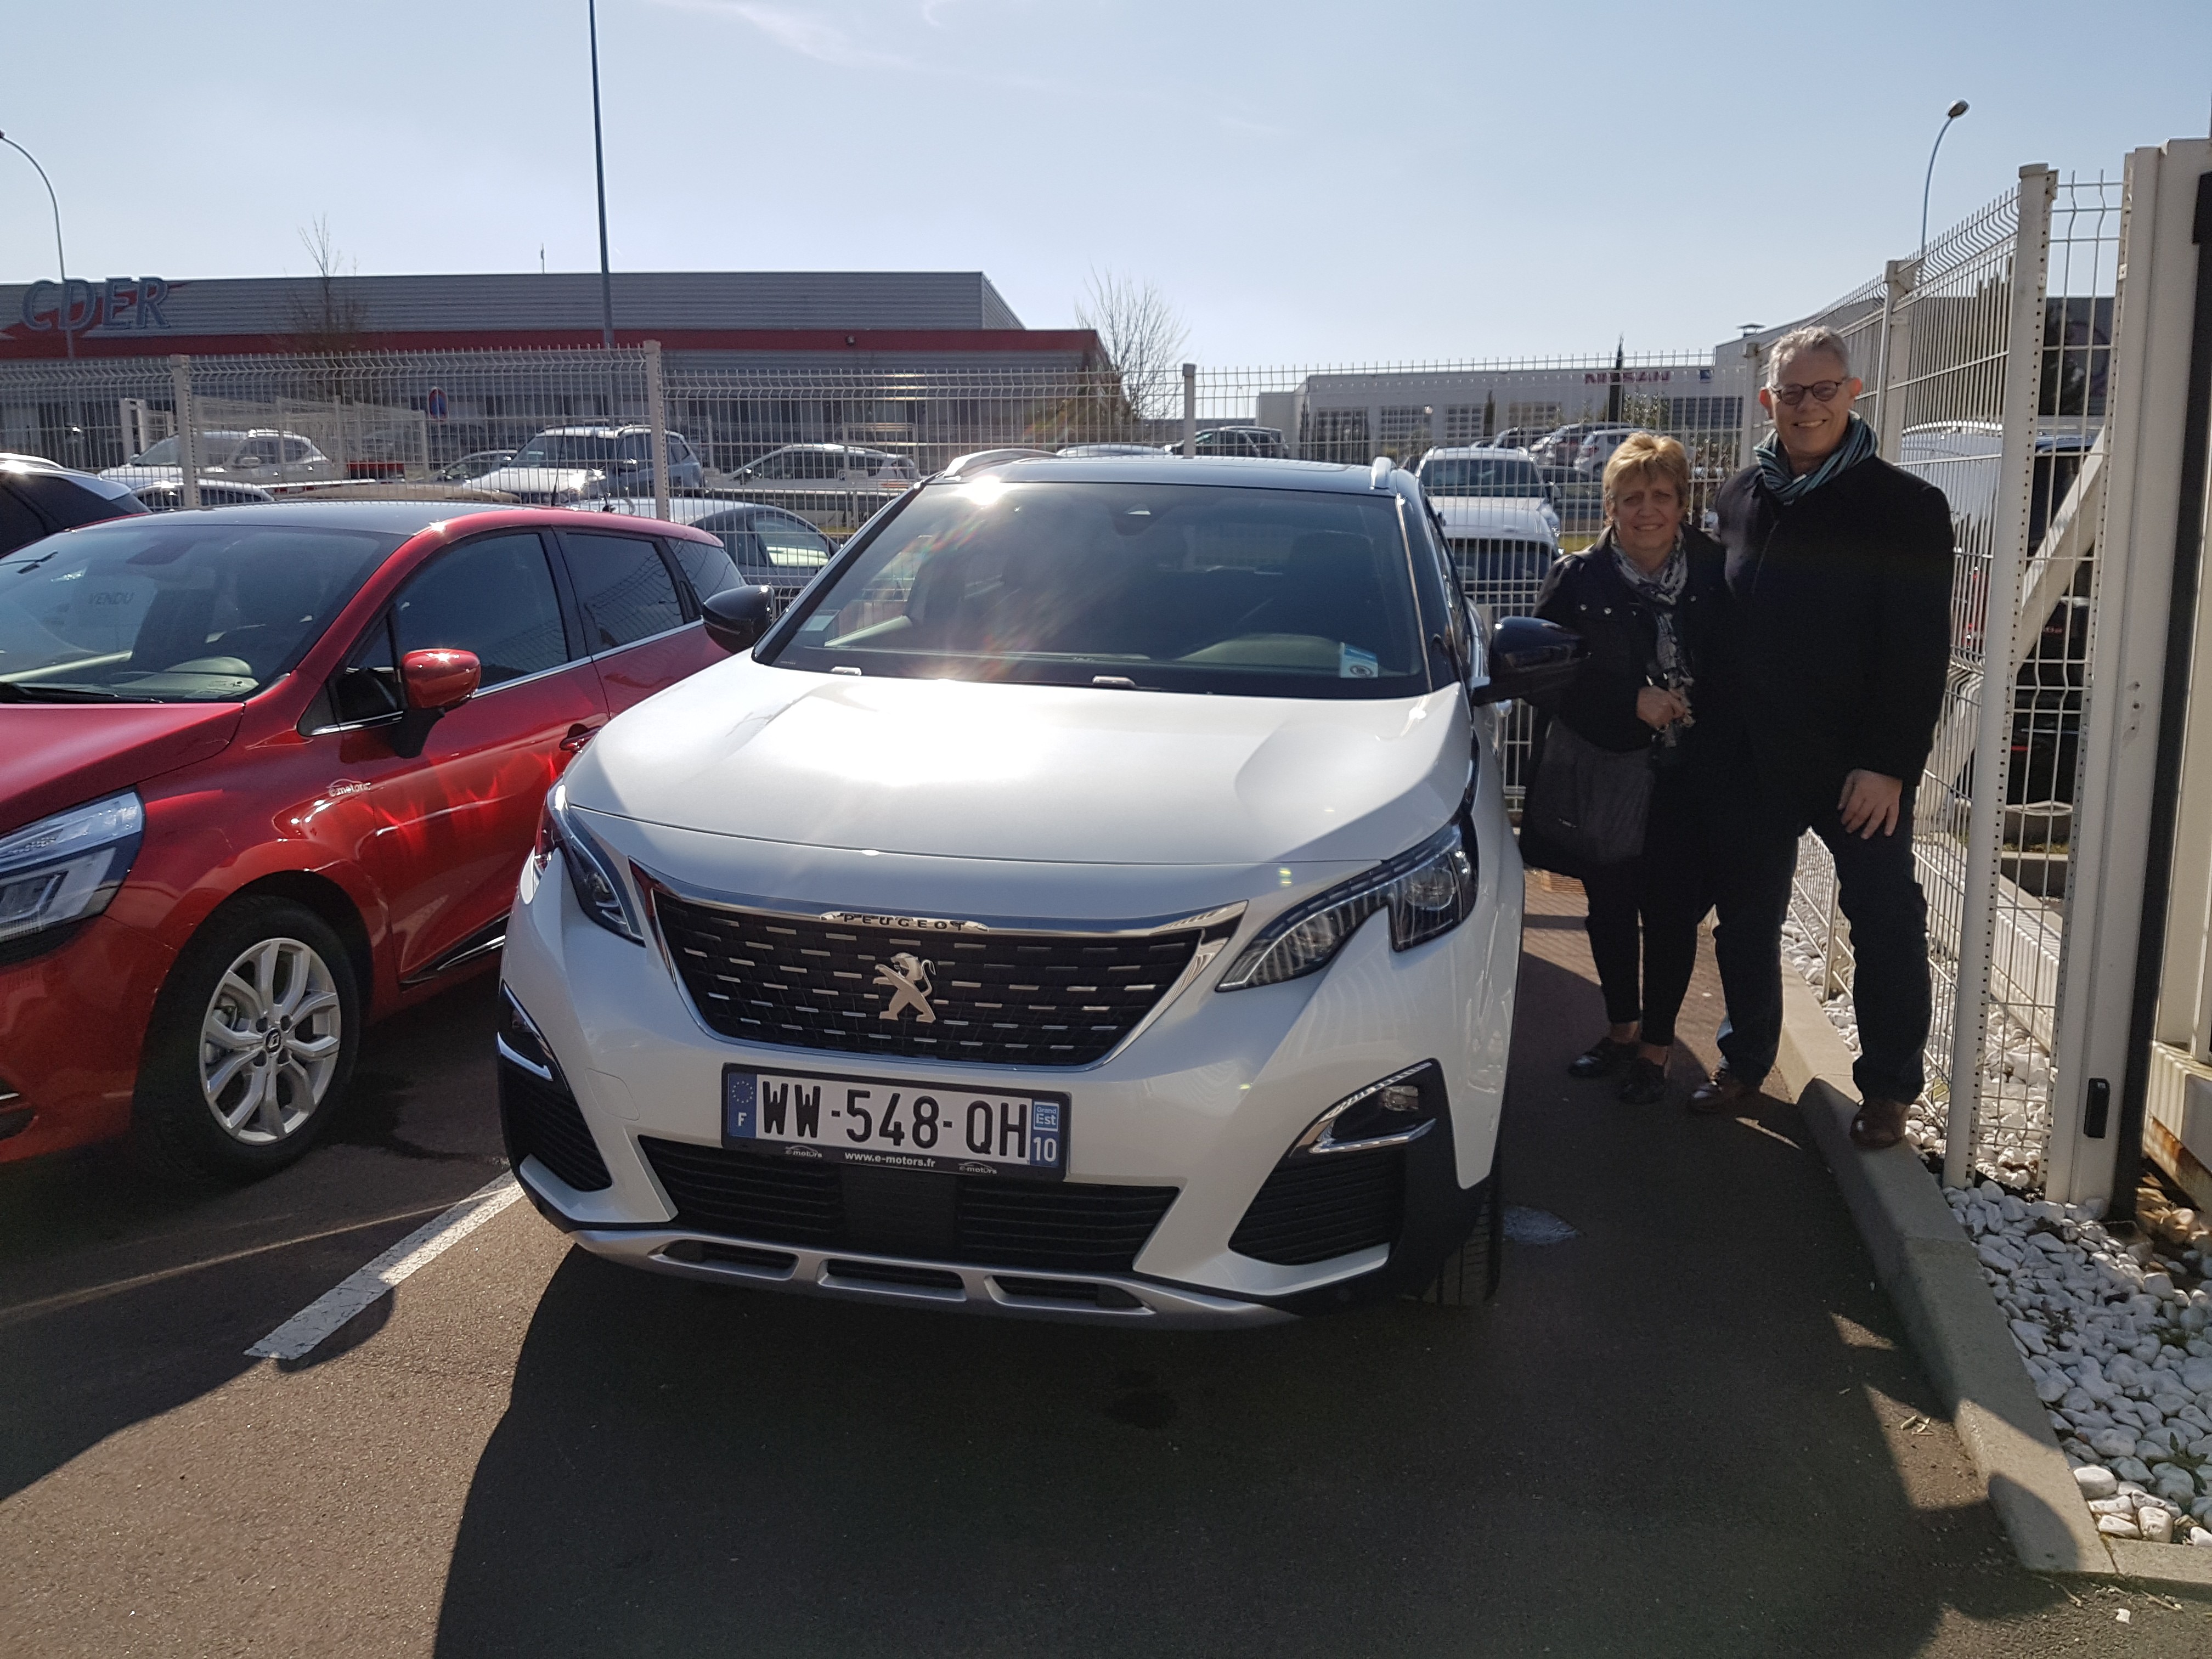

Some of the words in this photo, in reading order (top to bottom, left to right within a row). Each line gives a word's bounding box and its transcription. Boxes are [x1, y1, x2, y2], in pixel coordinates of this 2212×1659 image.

[22, 277, 171, 331] CDER
[1584, 371, 1671, 385] NISAN
[844, 913, 966, 931] PEUGEOT
[738, 1112, 747, 1126] F
[762, 1080, 1028, 1158] WW-548-QH
[1036, 1113, 1057, 1126] Est
[1034, 1137, 1057, 1162] 10
[845, 1152, 936, 1168] www.e-motors.fr
